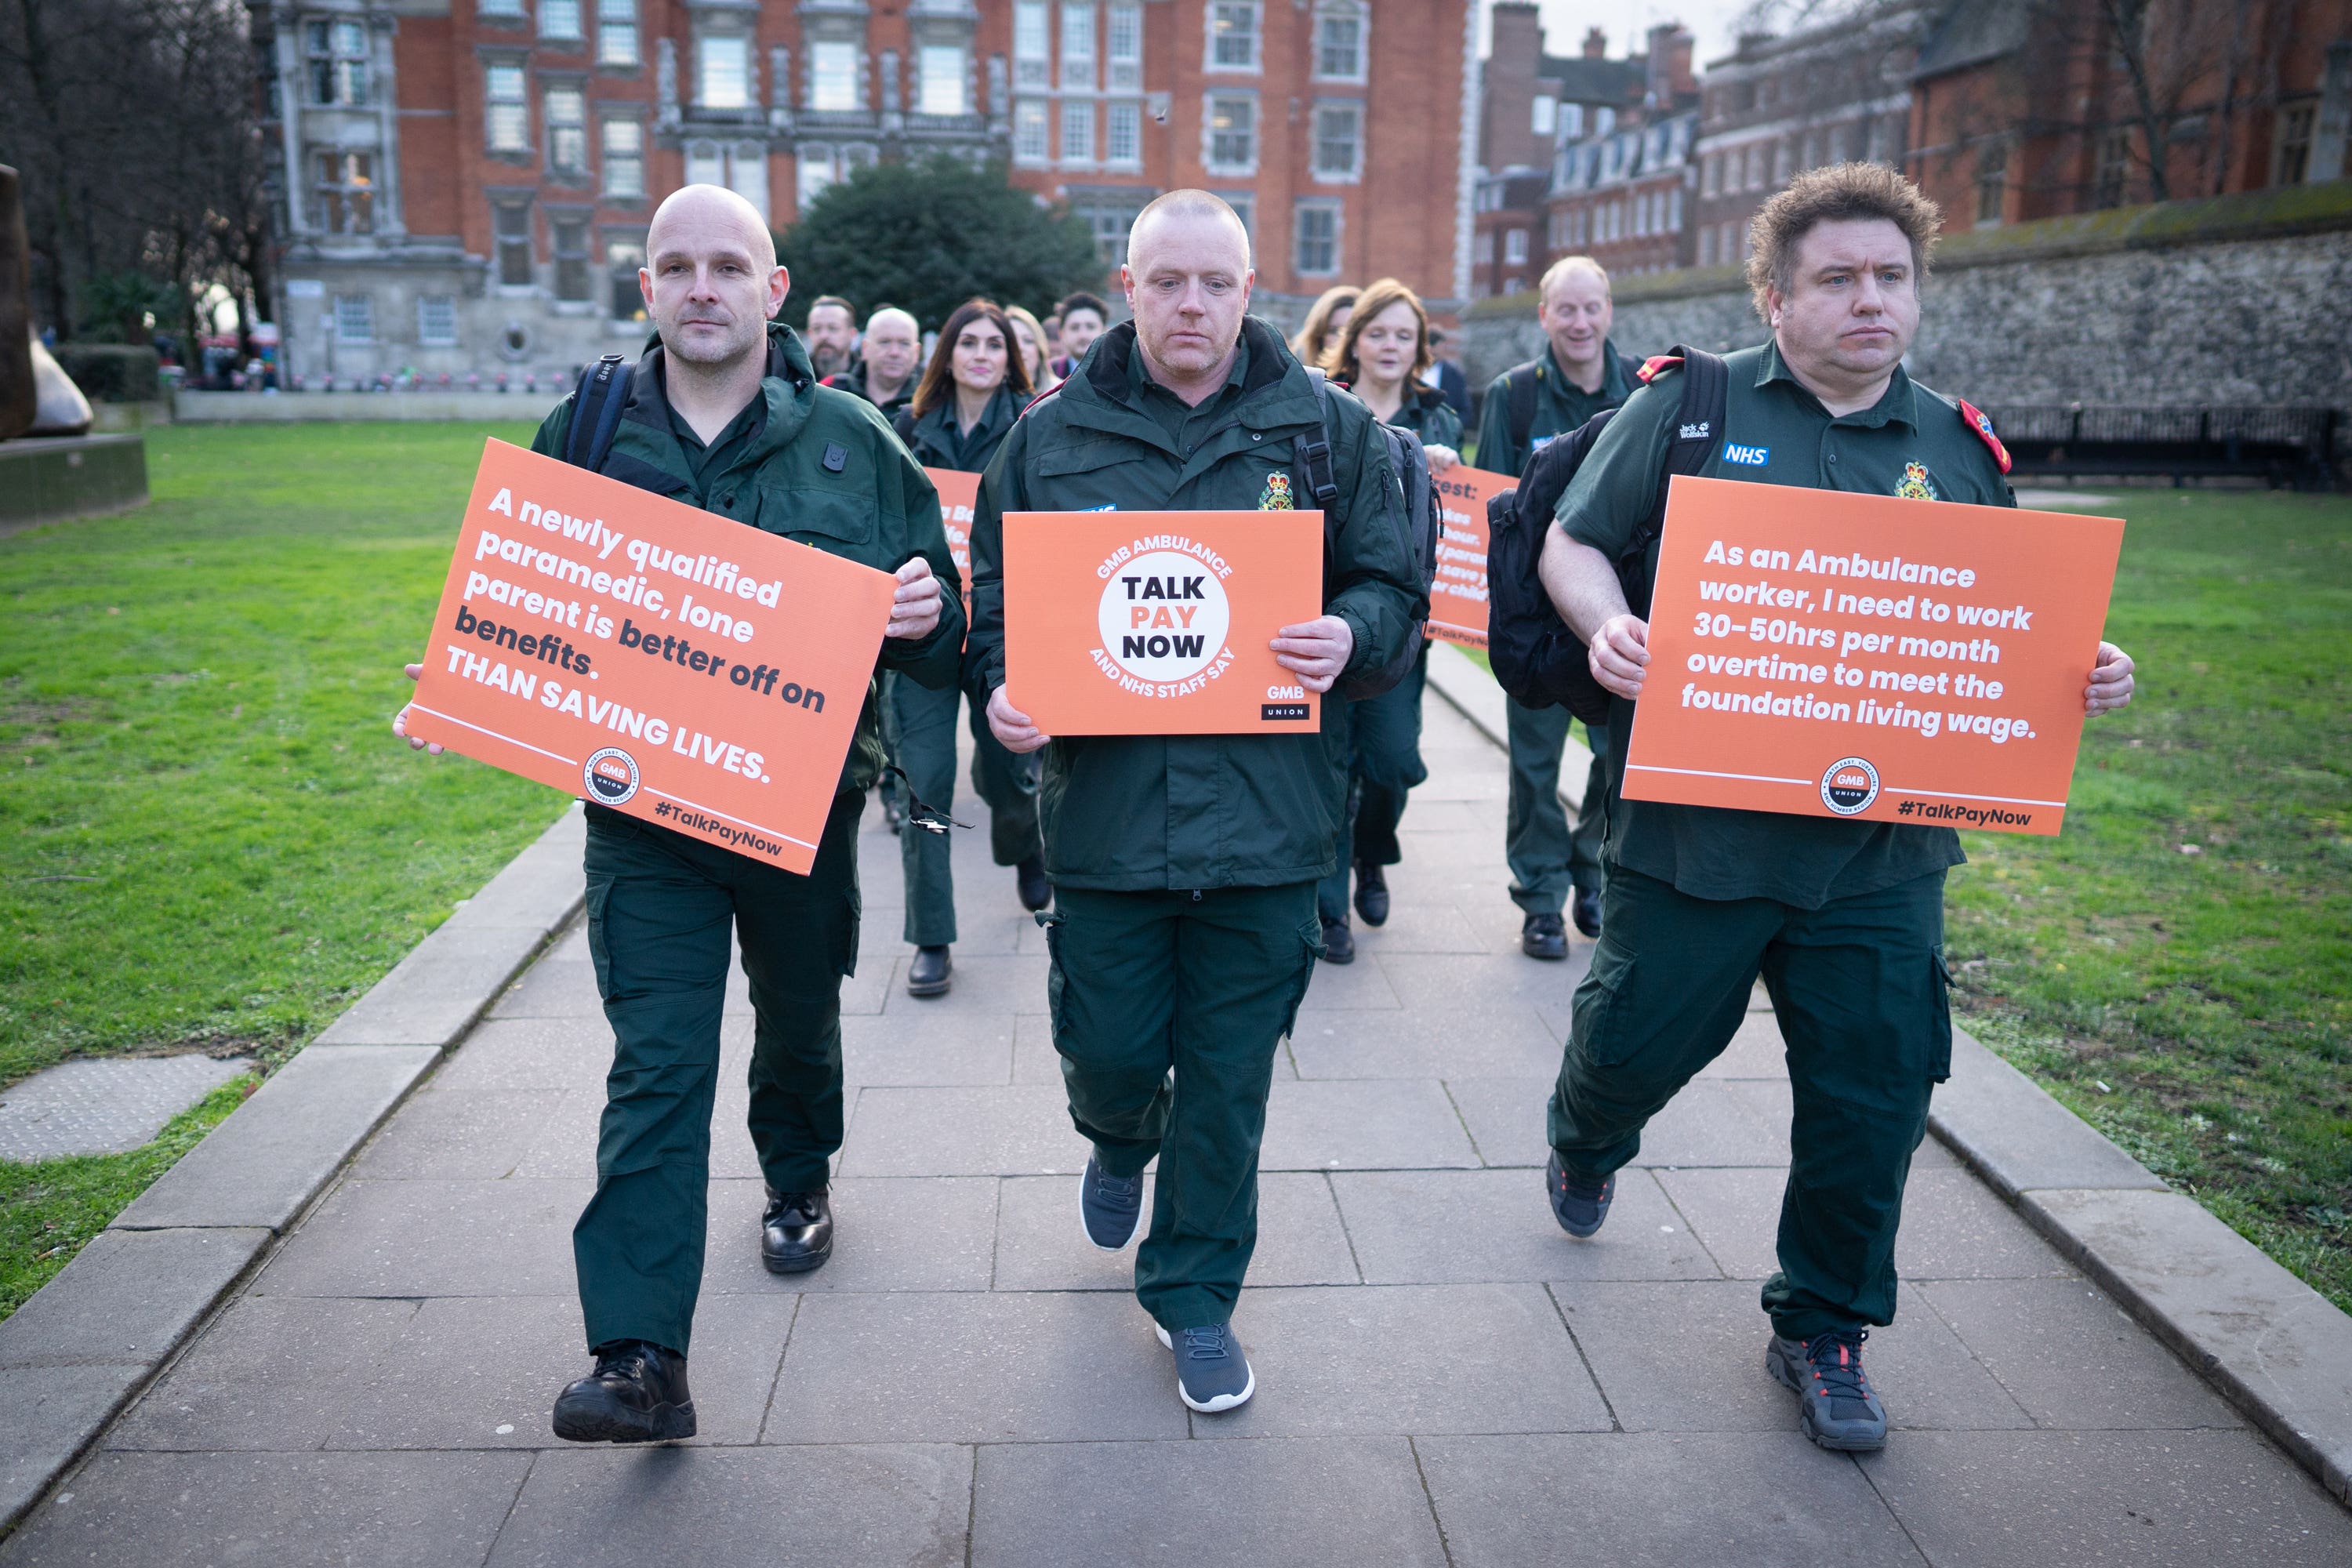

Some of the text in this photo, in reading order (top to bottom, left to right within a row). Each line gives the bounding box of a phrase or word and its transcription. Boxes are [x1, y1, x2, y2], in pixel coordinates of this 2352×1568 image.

[598, 363, 614, 380] Jeep
[1679, 423, 1697, 432] Jack
[1679, 430, 1709, 439] Wolfskin
[1725, 445, 1767, 464] NHS
[487, 487, 784, 609] A newly qualified
[1097, 535, 1233, 580] GMB AMBULANCE
[1704, 539, 1976, 588] As an Ambulance
[474, 529, 755, 644] paramedic, lone
[1121, 575, 1206, 600] TALK
[1131, 605, 1198, 630] PAY
[1699, 579, 2034, 631] worker, I need to work
[454, 604, 599, 681] benefits.
[463, 570, 826, 713] parent is better off on
[1123, 634, 1205, 659] NOW
[1693, 612, 2000, 664] 30-50hrs per month
[1089, 646, 1236, 699] AND NHS STAFF SAY
[1686, 652, 2004, 700] overtime to meet the
[1267, 684, 1305, 699] GMB
[446, 644, 771, 784] THAN SAVING LIVES.
[1682, 682, 2037, 744] foundation living wage.
[588, 752, 604, 768] NORTH
[622, 753, 637, 783] YORKSHIRE
[600, 762, 626, 779] GMB
[1824, 765, 1839, 783] NORTH
[1858, 761, 1877, 787] YORKSHIRE
[1837, 774, 1864, 786] GMB
[591, 789, 612, 803] HUMBER
[613, 790, 632, 803] REGION
[597, 777, 622, 789] UNION
[1831, 803, 1853, 813] HUMBER
[1853, 796, 1872, 811] REGION
[1897, 800, 2032, 827] #TalkPayNow
[655, 801, 782, 856] #TalkPayNow
